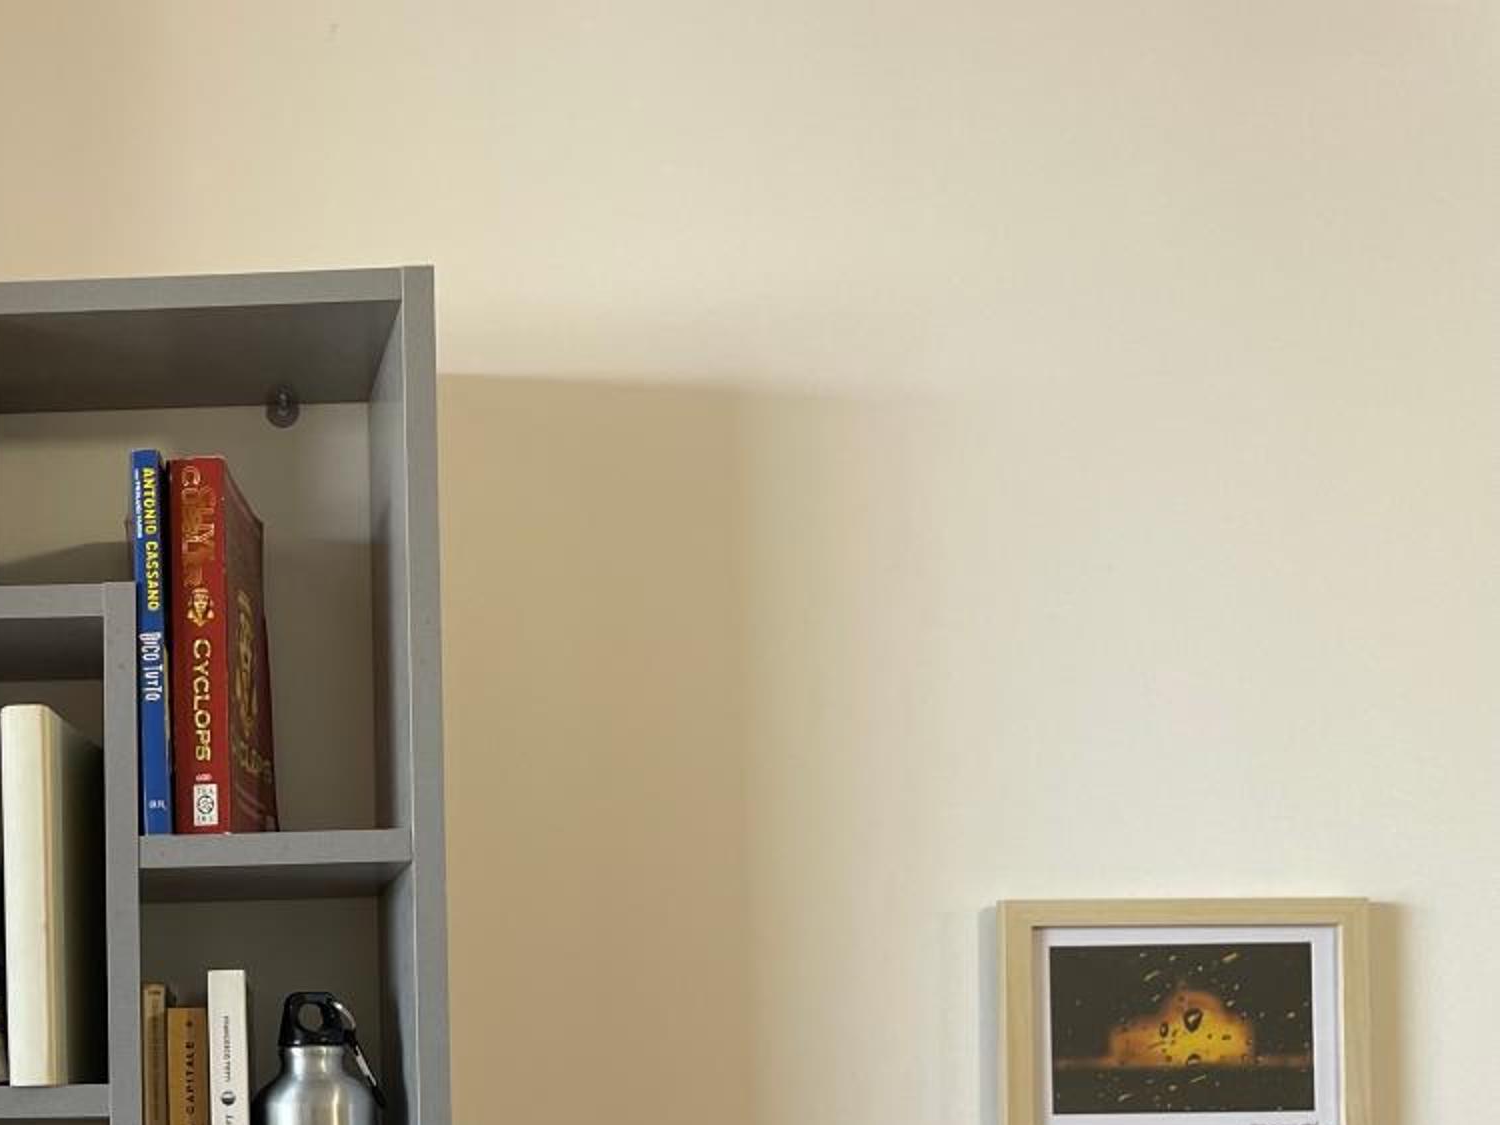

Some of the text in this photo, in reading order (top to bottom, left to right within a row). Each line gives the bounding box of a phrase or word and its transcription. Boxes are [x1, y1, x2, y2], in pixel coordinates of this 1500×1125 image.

[142, 467, 161, 611] ANTONIO CASSANO
[139, 631, 162, 661] DICO
[193, 639, 211, 761] CYCLOPS
[185, 1041, 197, 1113] CAPITALE
